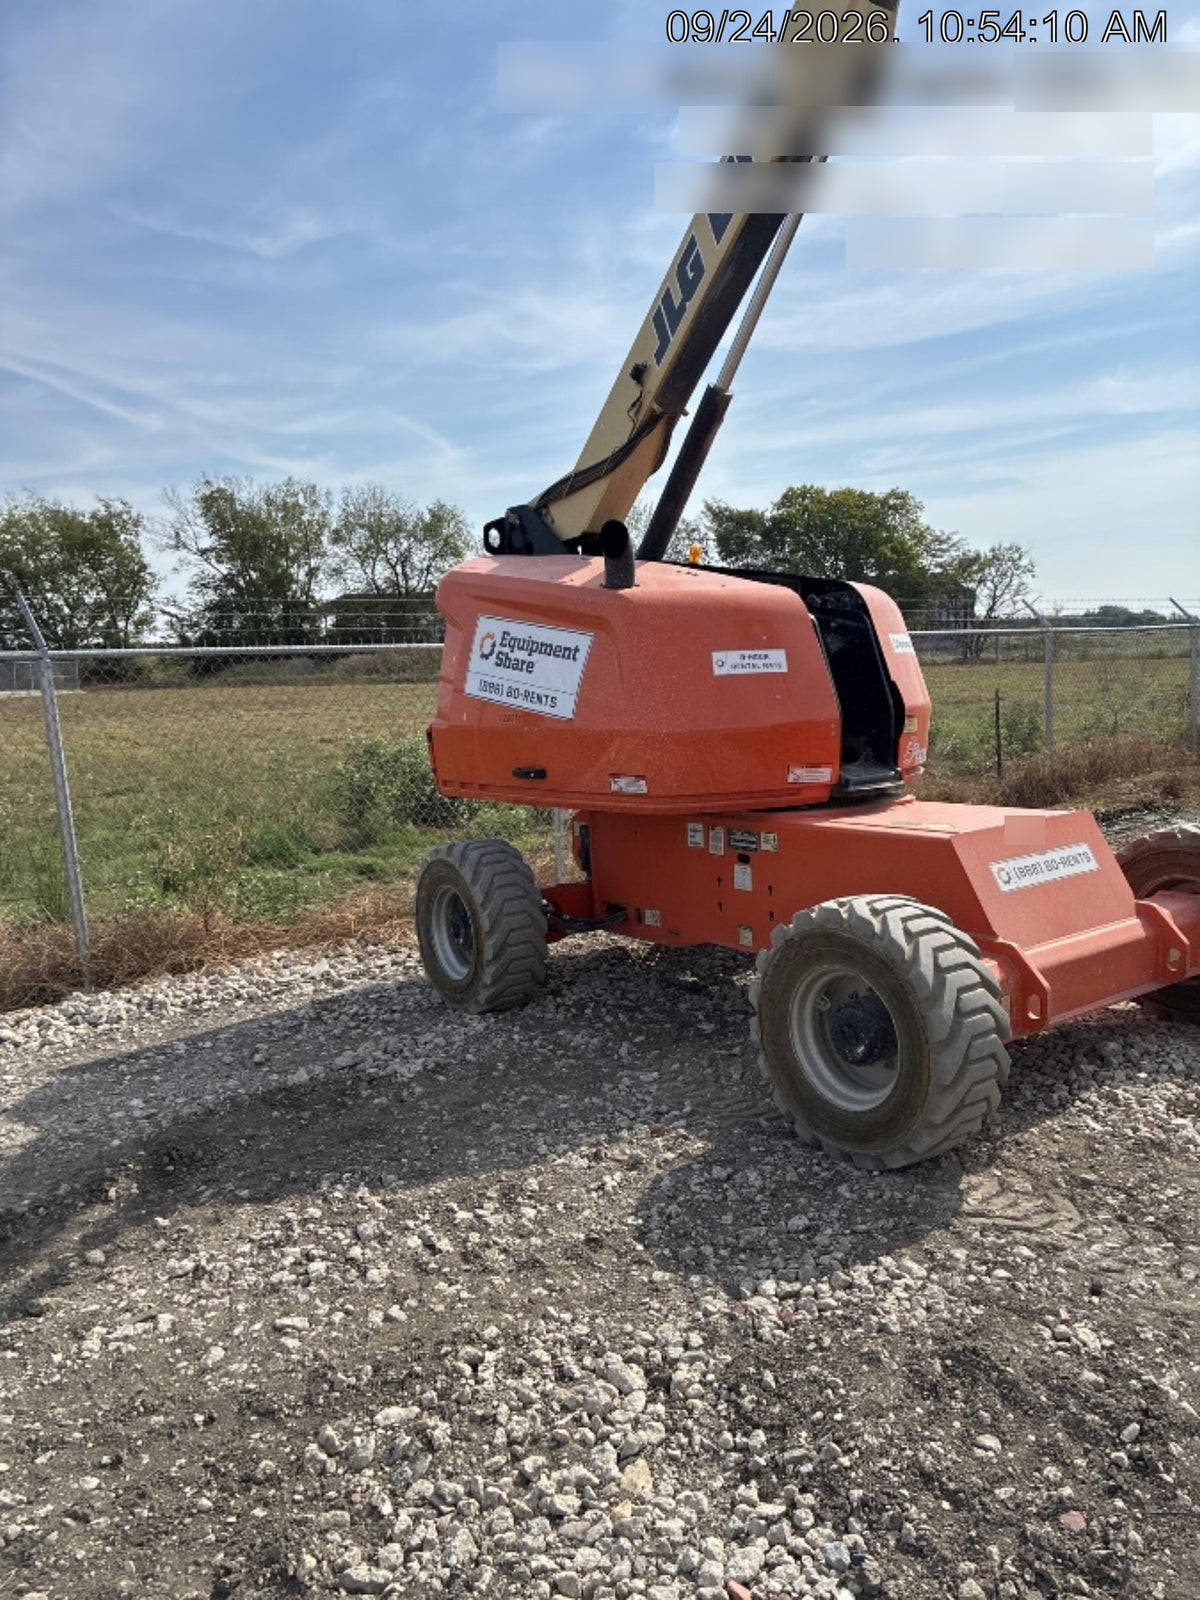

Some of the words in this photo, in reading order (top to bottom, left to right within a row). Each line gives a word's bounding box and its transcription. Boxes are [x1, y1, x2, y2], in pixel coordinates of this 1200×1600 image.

[652, 231, 705, 368] JLG
[499, 630, 580, 662] Equipment
[495, 651, 535, 674] Share
